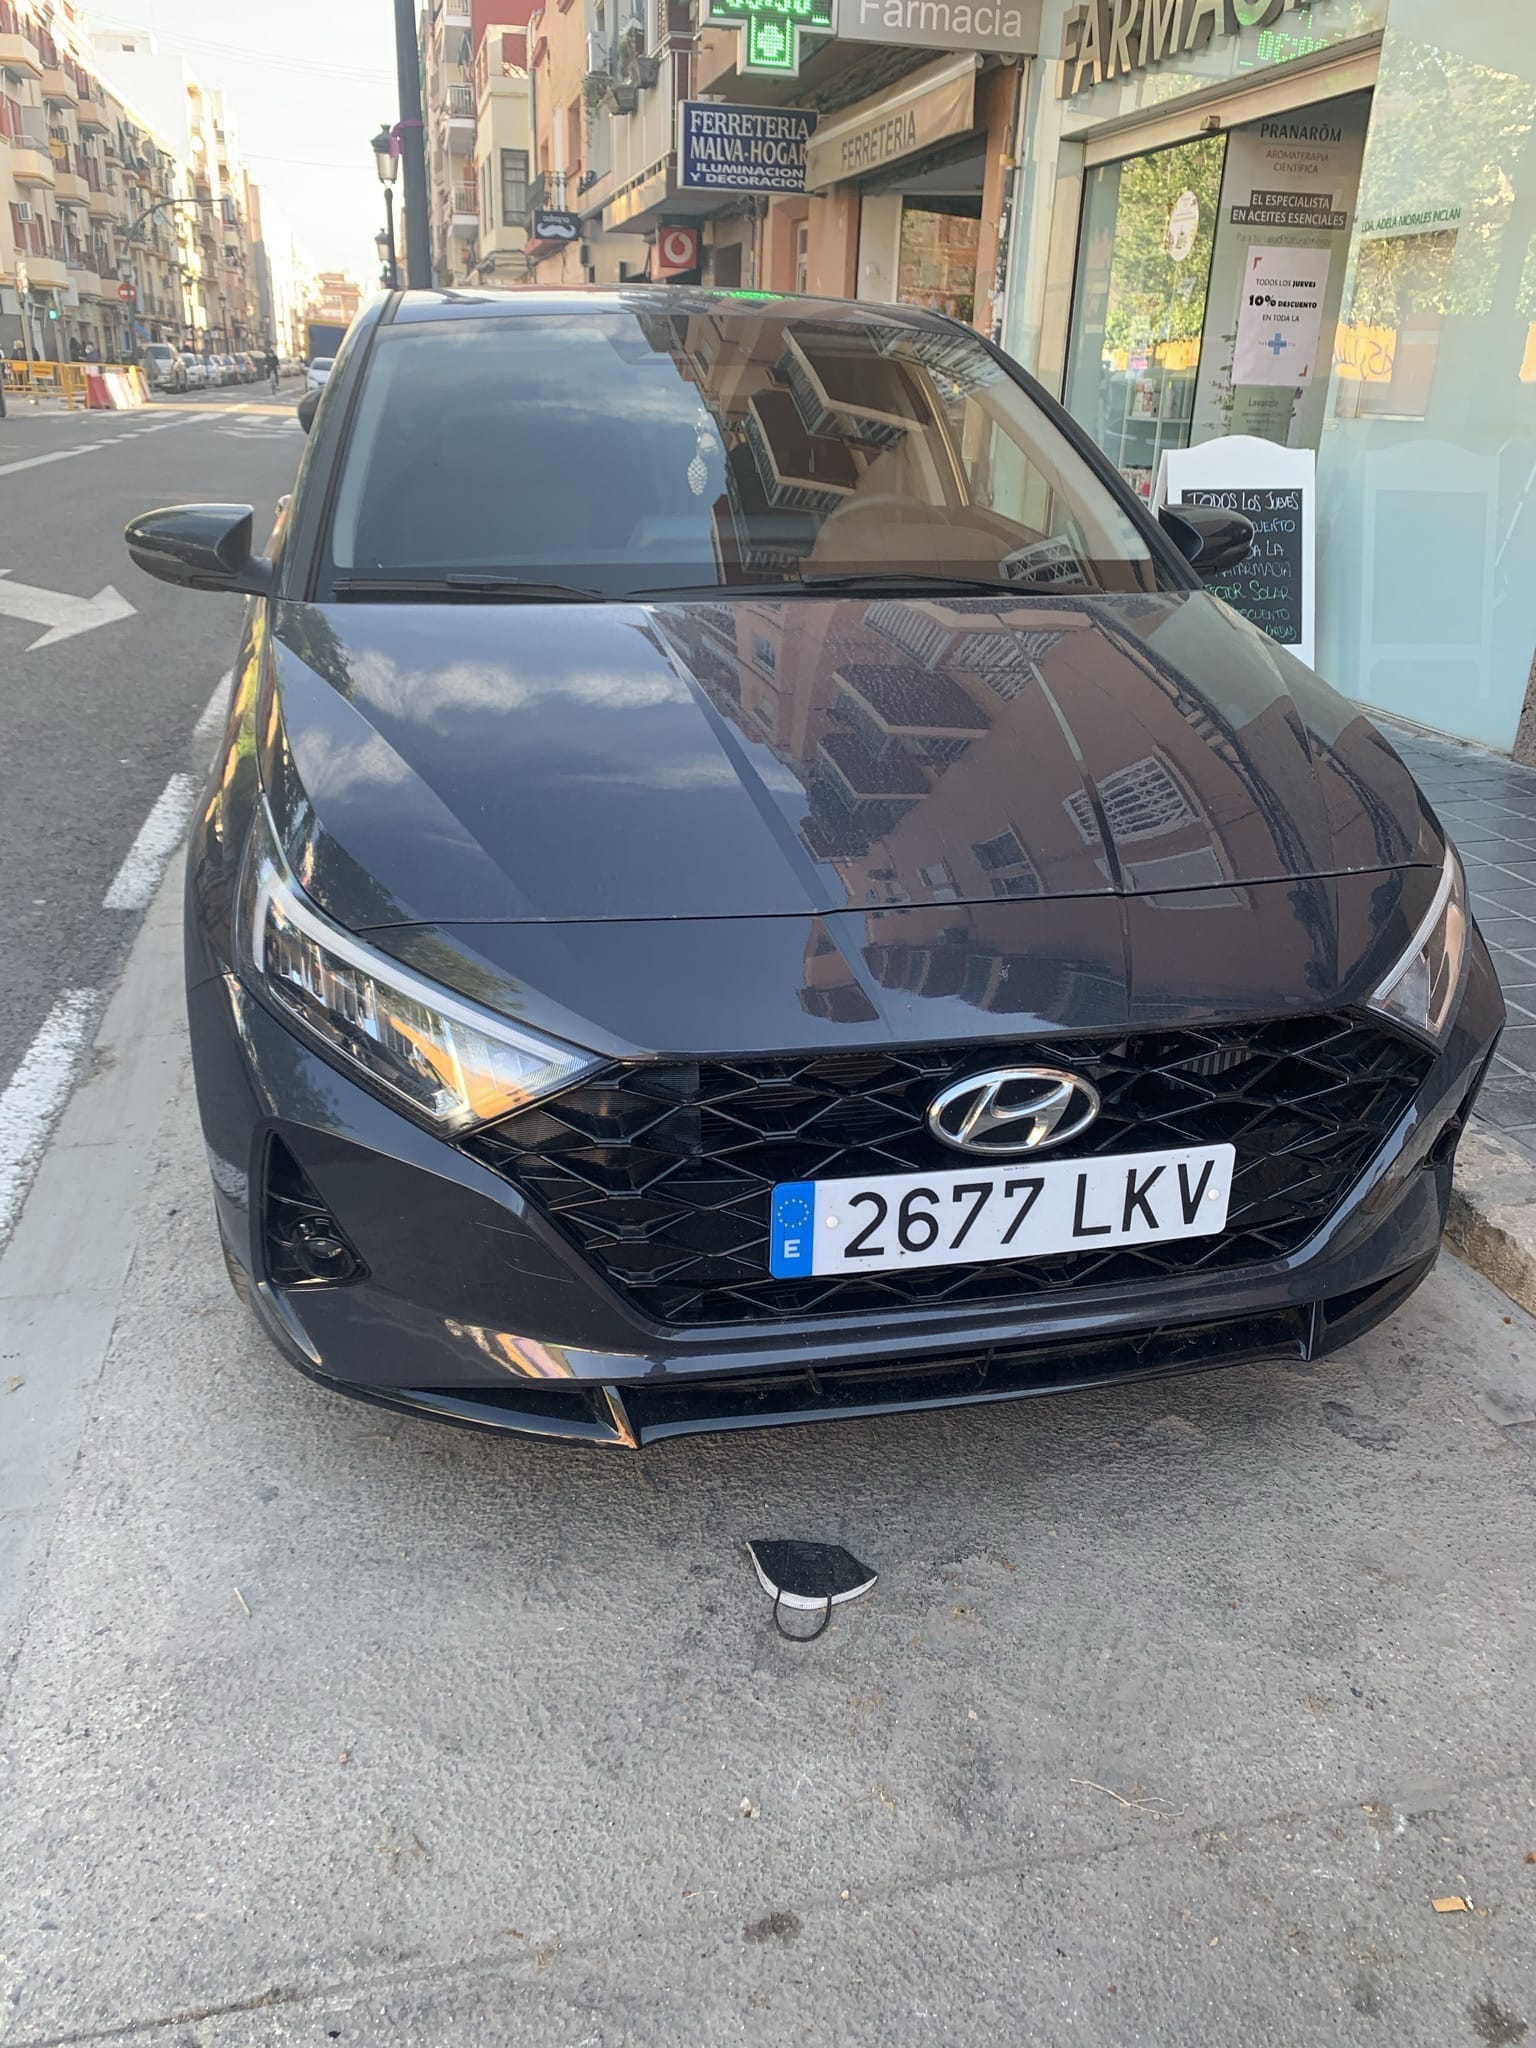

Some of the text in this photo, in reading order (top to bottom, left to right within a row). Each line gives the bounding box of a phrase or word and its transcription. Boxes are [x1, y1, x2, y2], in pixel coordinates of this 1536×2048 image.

[858, 0, 1022, 38] Farmacia
[1055, 0, 1332, 100] FARMA
[690, 110, 810, 139] FERRETERIA
[840, 110, 917, 172] FERRETERIA
[1266, 149, 1329, 162] AROMATERAPIA
[696, 162, 804, 178] ILUMINACION
[690, 172, 806, 188] Y DECORACION
[1252, 193, 1330, 209] EL ESPECIALISTA
[1232, 209, 1344, 226] EN ACEITES ESENCIALES
[1256, 278, 1316, 288] TODOS LOS JUEVES
[1249, 294, 1318, 309] 10% DESCUENTO
[1262, 313, 1272, 321] EN
[1273, 314, 1290, 322] TODA
[1188, 490, 1299, 512] TODOS LOS JUEVES
[1266, 539, 1284, 557] LA
[1249, 579, 1294, 601] SOLAR
[844, 1159, 1215, 1259] 2677 LKV
[783, 1239, 801, 1258] E
